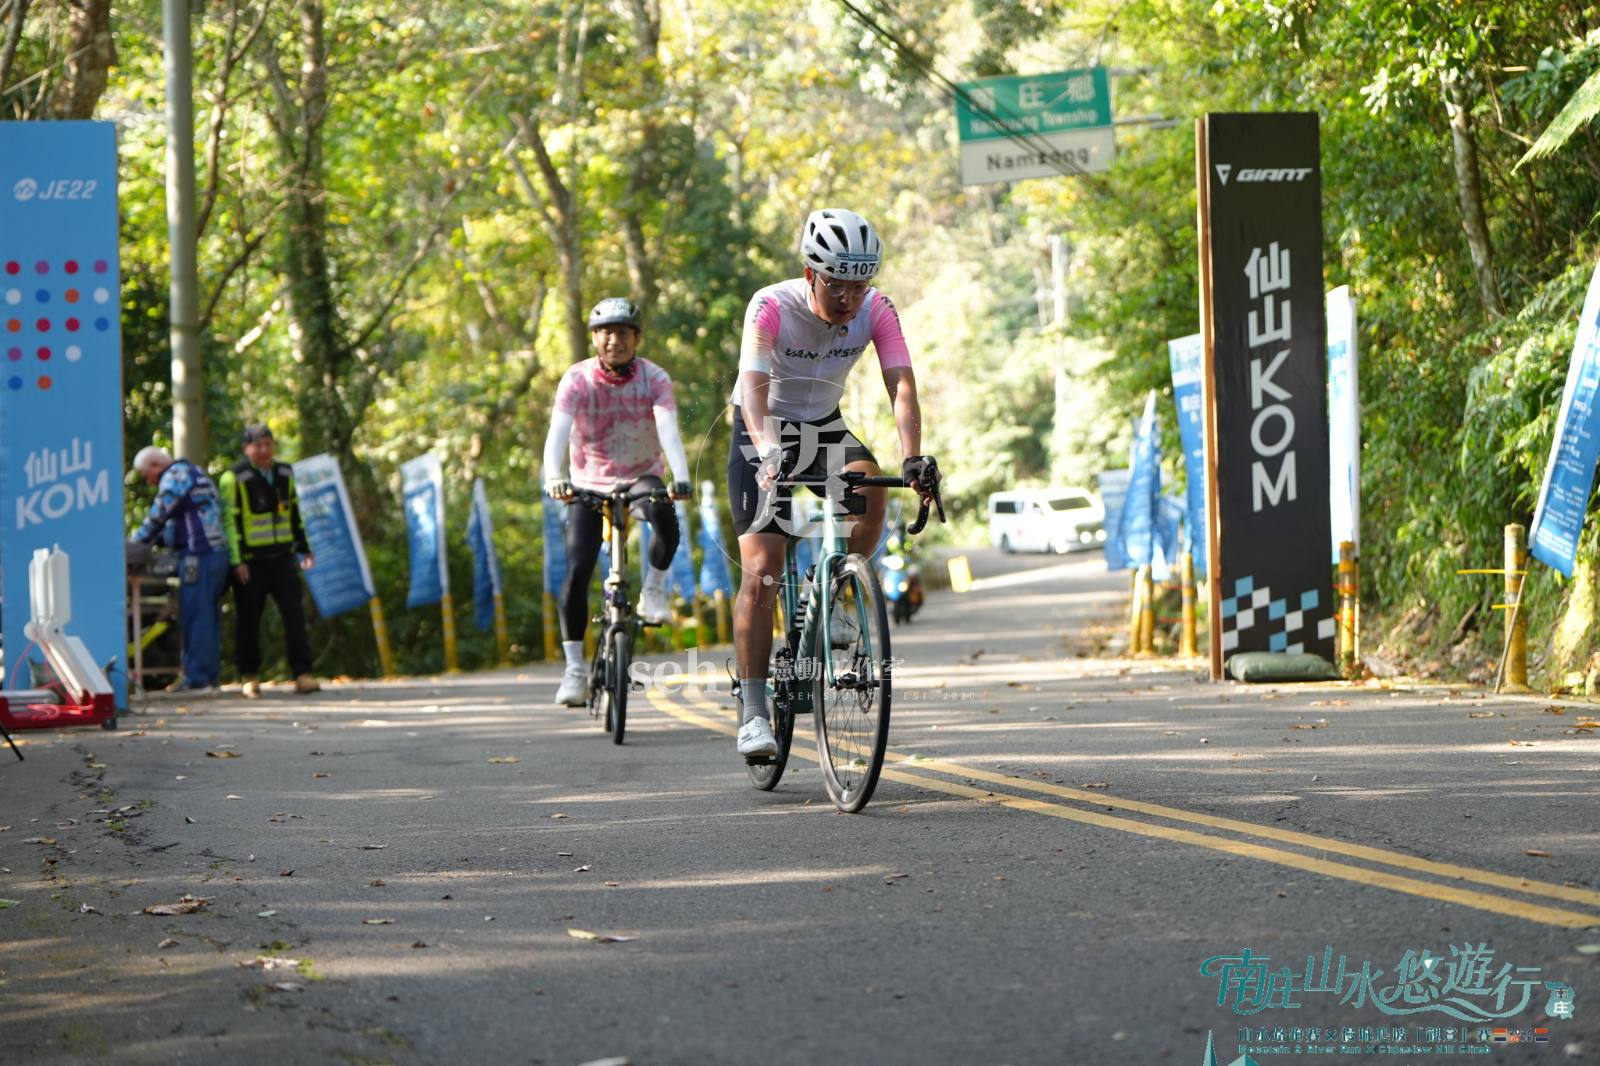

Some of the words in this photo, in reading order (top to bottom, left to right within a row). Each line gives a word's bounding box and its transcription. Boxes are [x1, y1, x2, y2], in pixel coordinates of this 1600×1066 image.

[1042, 109, 1096, 126] Township
[38, 179, 97, 200] JE22
[1236, 168, 1313, 183] GIANT
[1244, 241, 1292, 348] 仙山
[823, 345, 866, 360] RYSE
[1251, 349, 1297, 513] KOM
[24, 437, 92, 489] 仙山
[15, 469, 110, 530] KOM
